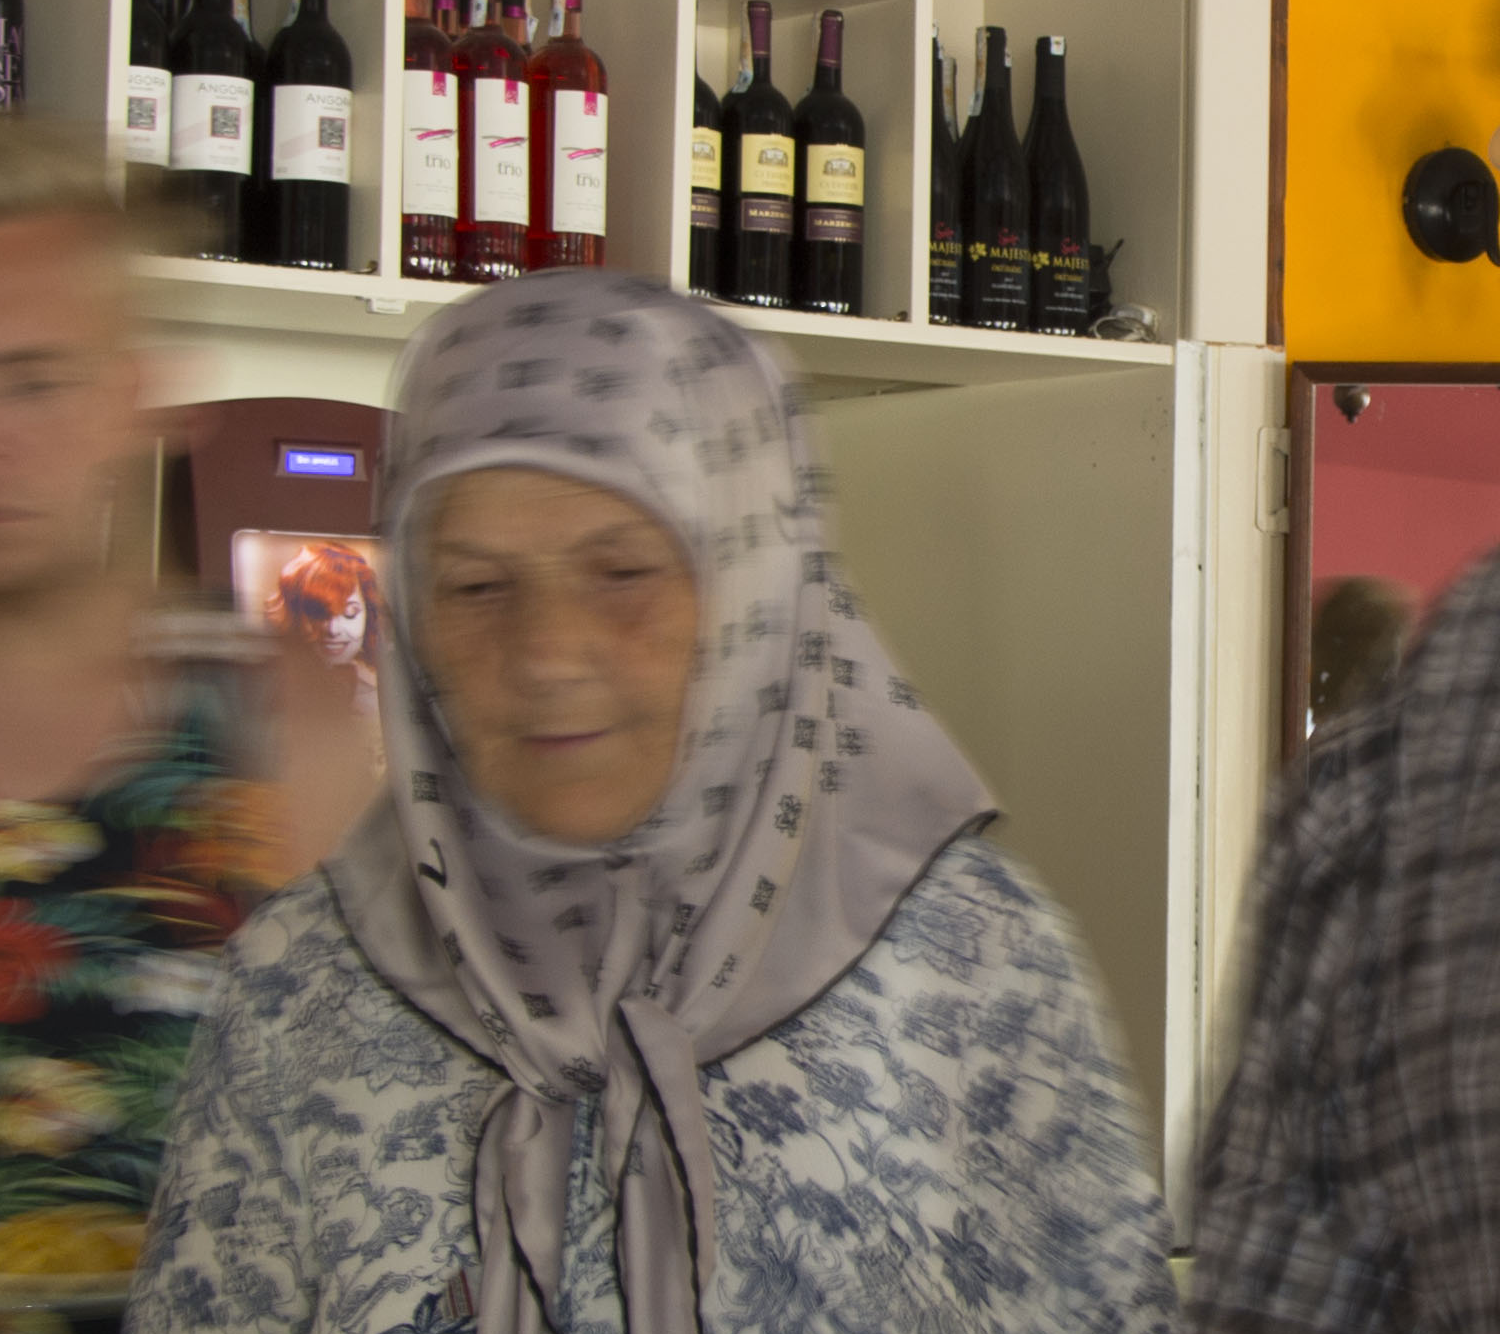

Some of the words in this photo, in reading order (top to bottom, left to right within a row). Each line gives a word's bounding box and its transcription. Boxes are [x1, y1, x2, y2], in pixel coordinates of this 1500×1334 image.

[425, 155, 450, 170] trio
[497, 162, 522, 177] trio
[576, 173, 600, 188] trio
